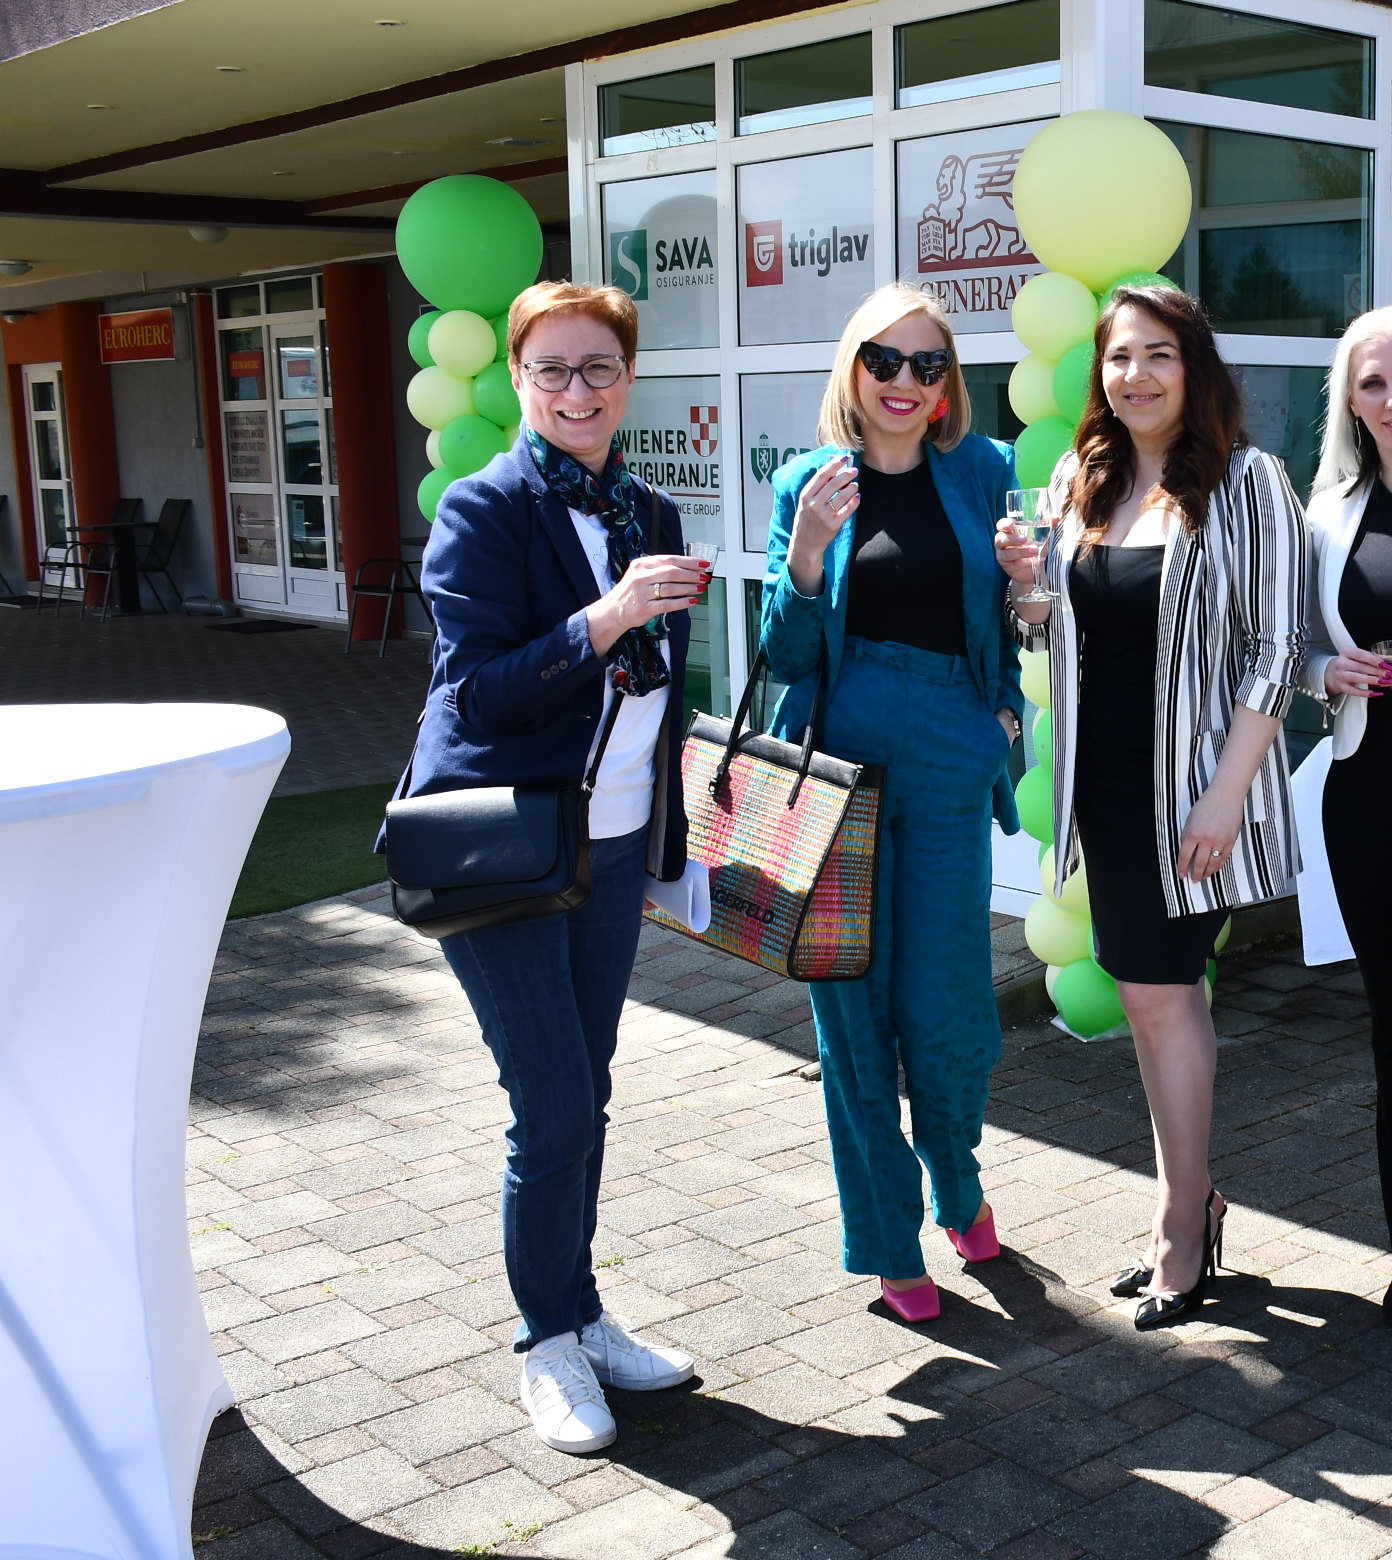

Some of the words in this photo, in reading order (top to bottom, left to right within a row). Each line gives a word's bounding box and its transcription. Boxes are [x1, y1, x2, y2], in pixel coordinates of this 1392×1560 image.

[655, 235, 714, 273] SAVA
[788, 225, 869, 277] triglav
[656, 273, 715, 288] OSIGURANJE
[104, 323, 170, 349] EUROHERC
[616, 429, 688, 455] WIENER
[628, 461, 720, 489] SIGURANJE
[693, 503, 721, 517] GROUP
